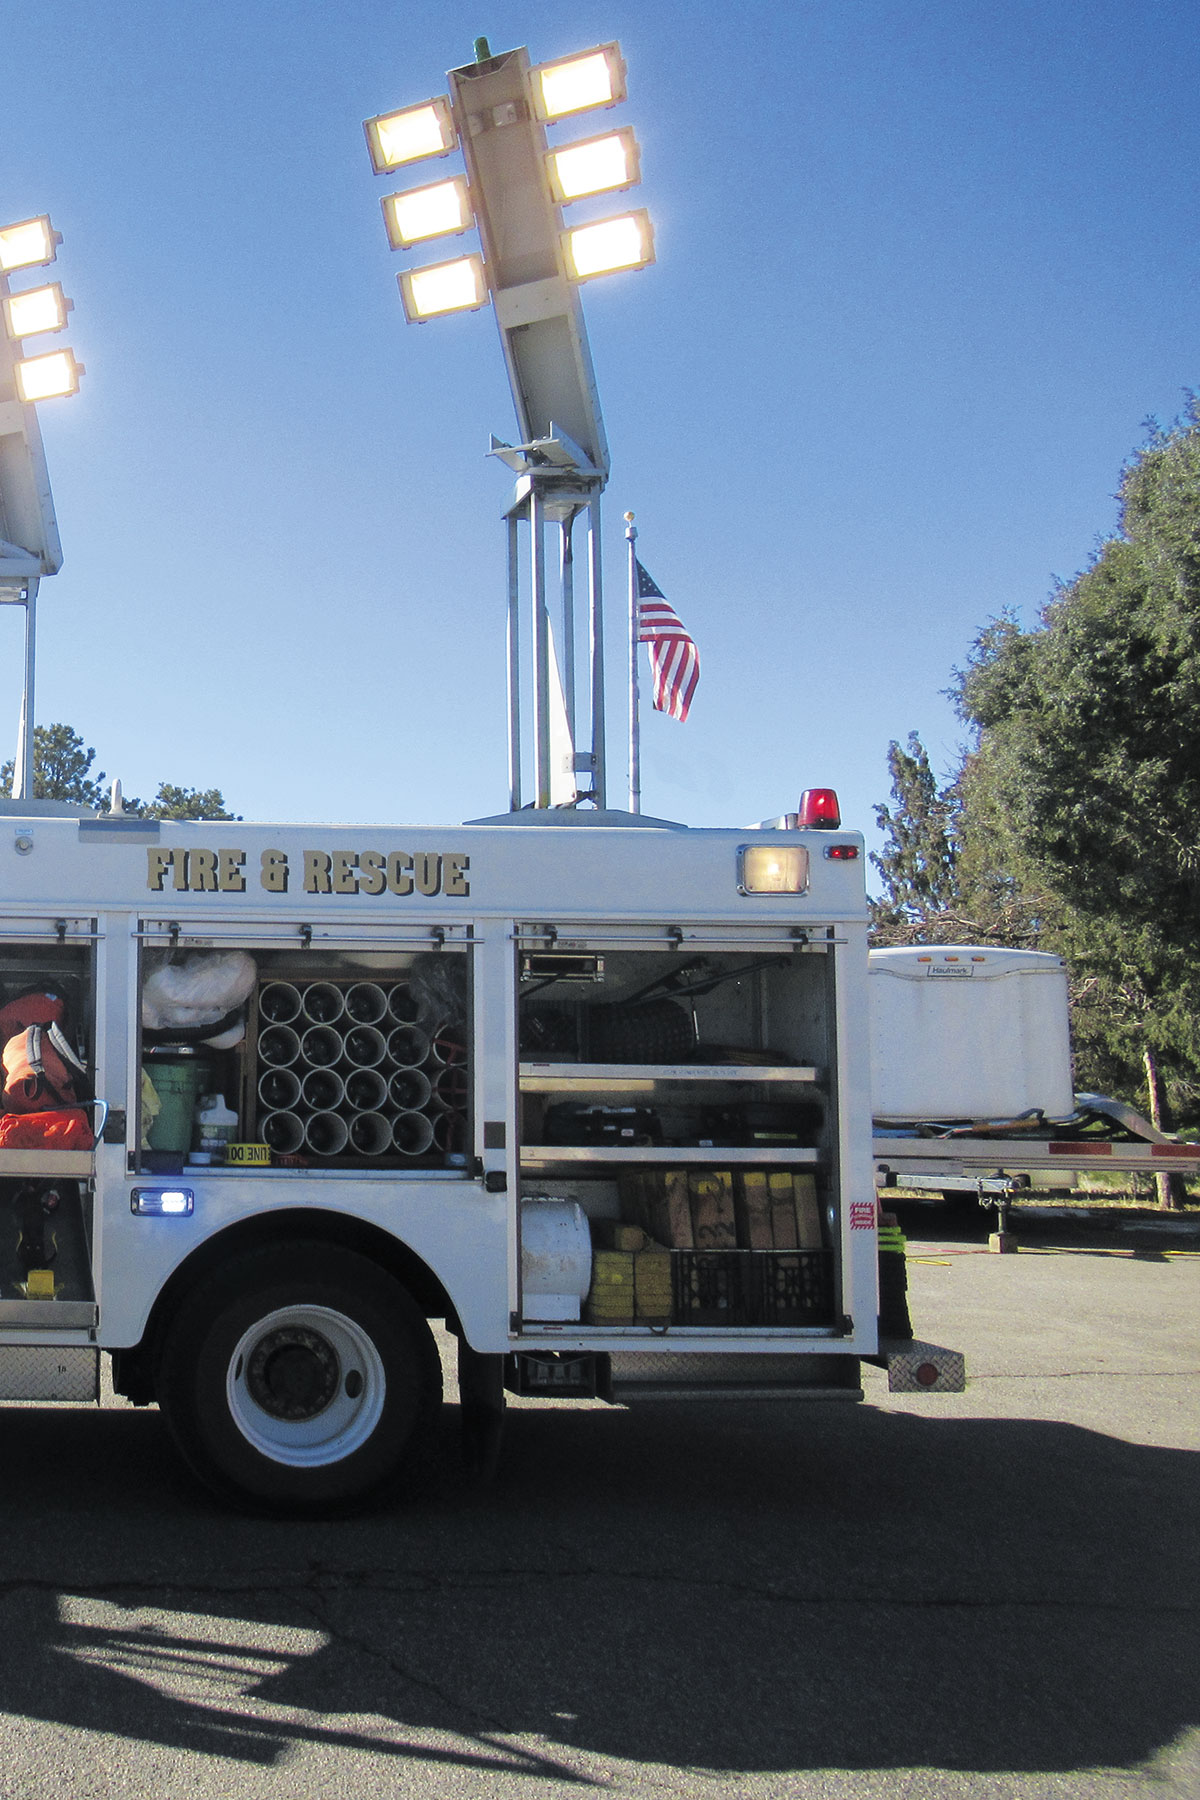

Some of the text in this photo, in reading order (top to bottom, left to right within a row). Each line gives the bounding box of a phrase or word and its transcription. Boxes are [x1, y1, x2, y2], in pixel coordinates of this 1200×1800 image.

[147, 847, 470, 897] FIRE & RESCUE
[231, 1146, 244, 1161] DO
[247, 1146, 267, 1160] LINE
